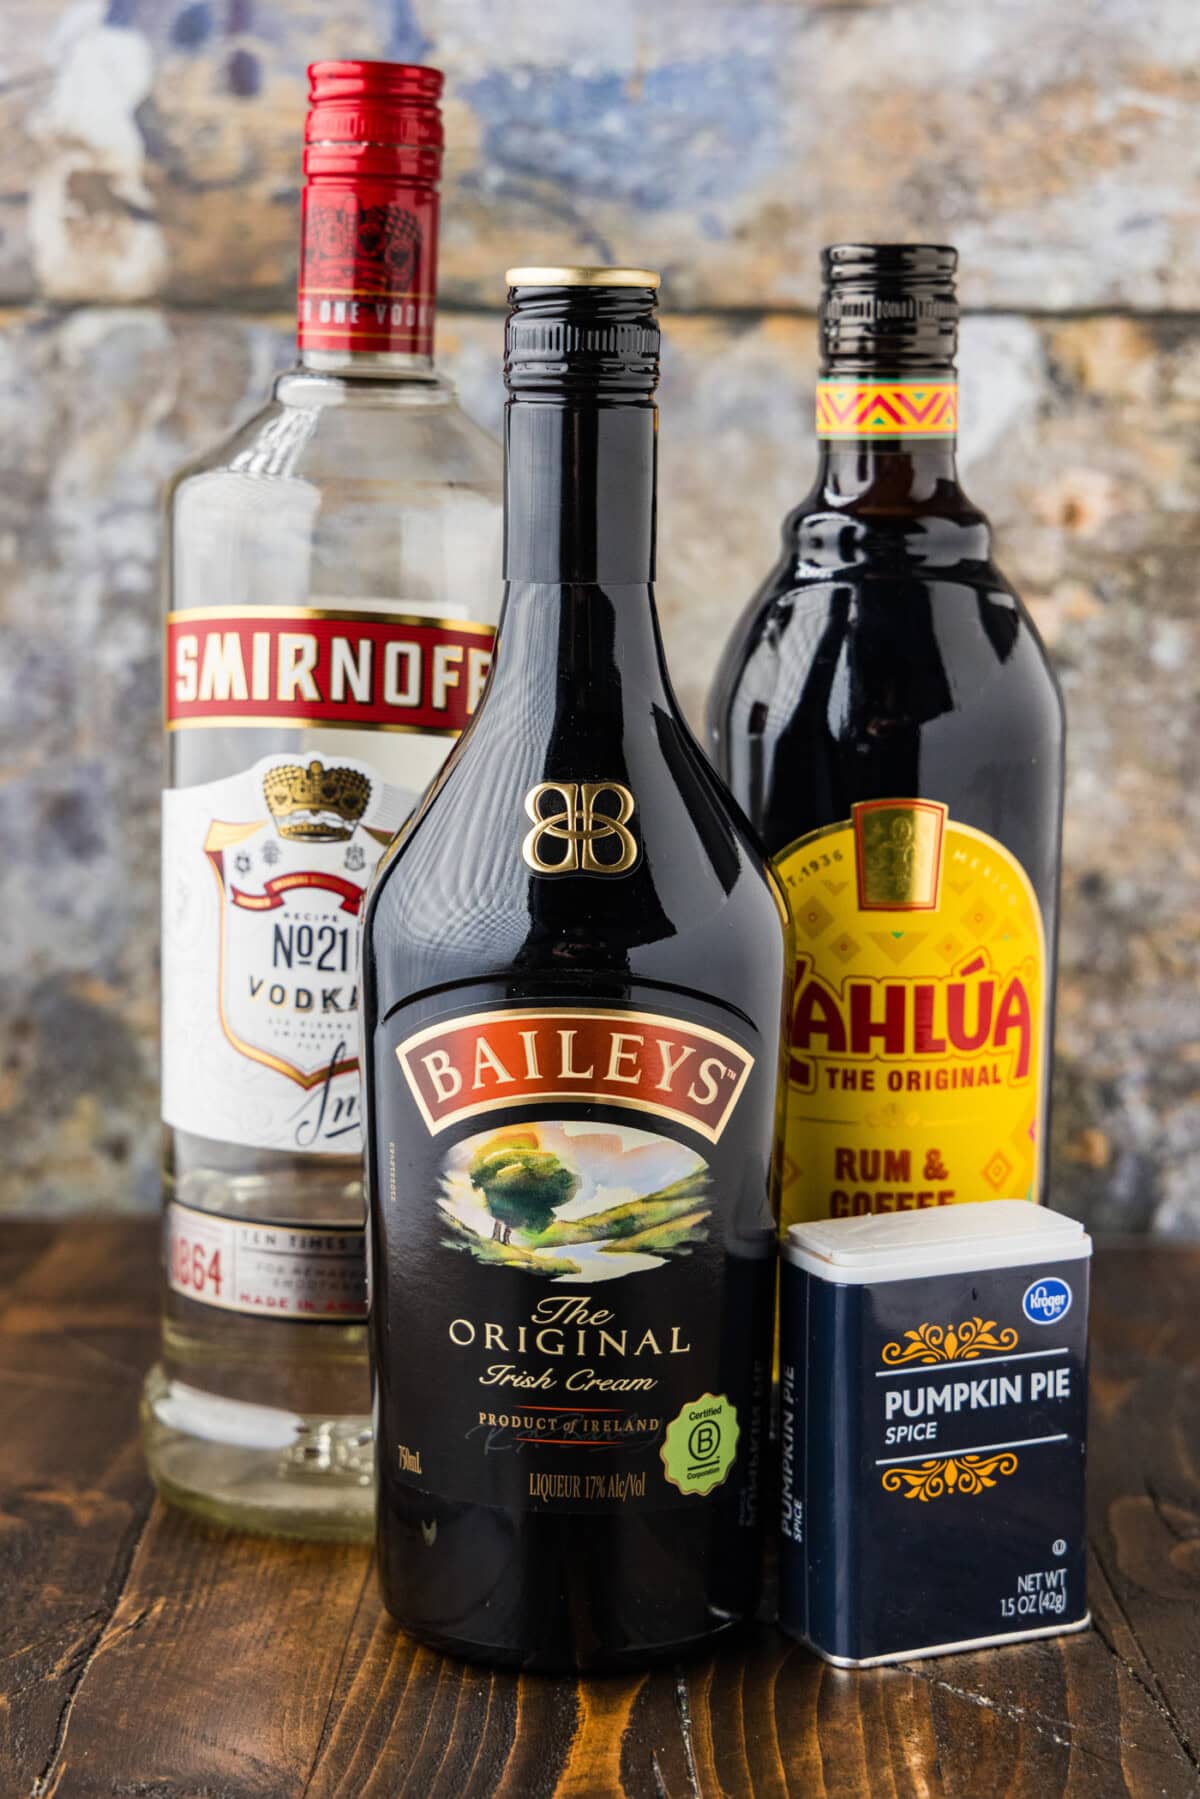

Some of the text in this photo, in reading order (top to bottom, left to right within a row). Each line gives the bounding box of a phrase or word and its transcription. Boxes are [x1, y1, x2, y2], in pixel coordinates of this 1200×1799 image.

[786, 850, 844, 888] T.1936
[825, 1063, 1003, 1092] THE ORIGINAL
[834, 1147, 949, 1183] RUM &
[241, 1230, 278, 1246] TEN
[289, 1234, 347, 1251] TIMES
[240, 1292, 289, 1309] MADE
[297, 1298, 317, 1312] IN
[530, 1295, 616, 1326] The
[1029, 1286, 1067, 1317] Kroger
[449, 1318, 692, 1357] ORIGINAL
[478, 1364, 660, 1392] Irish Cream
[884, 1367, 1071, 1421] PUMPKIN PIE
[478, 1411, 661, 1434] PRODUCT of IRELAND
[688, 1404, 723, 1421] Certified
[884, 1421, 938, 1445] SPICE
[781, 1365, 796, 1537] PUMPKIN PIE
[528, 1471, 647, 1503] LIQUEUR 17% Alc/Vol
[792, 1499, 803, 1544] SPICE
[1017, 1567, 1068, 1594] NET WT
[1017, 1594, 1038, 1615] OZ
[1038, 1586, 1067, 1615] (42g)
